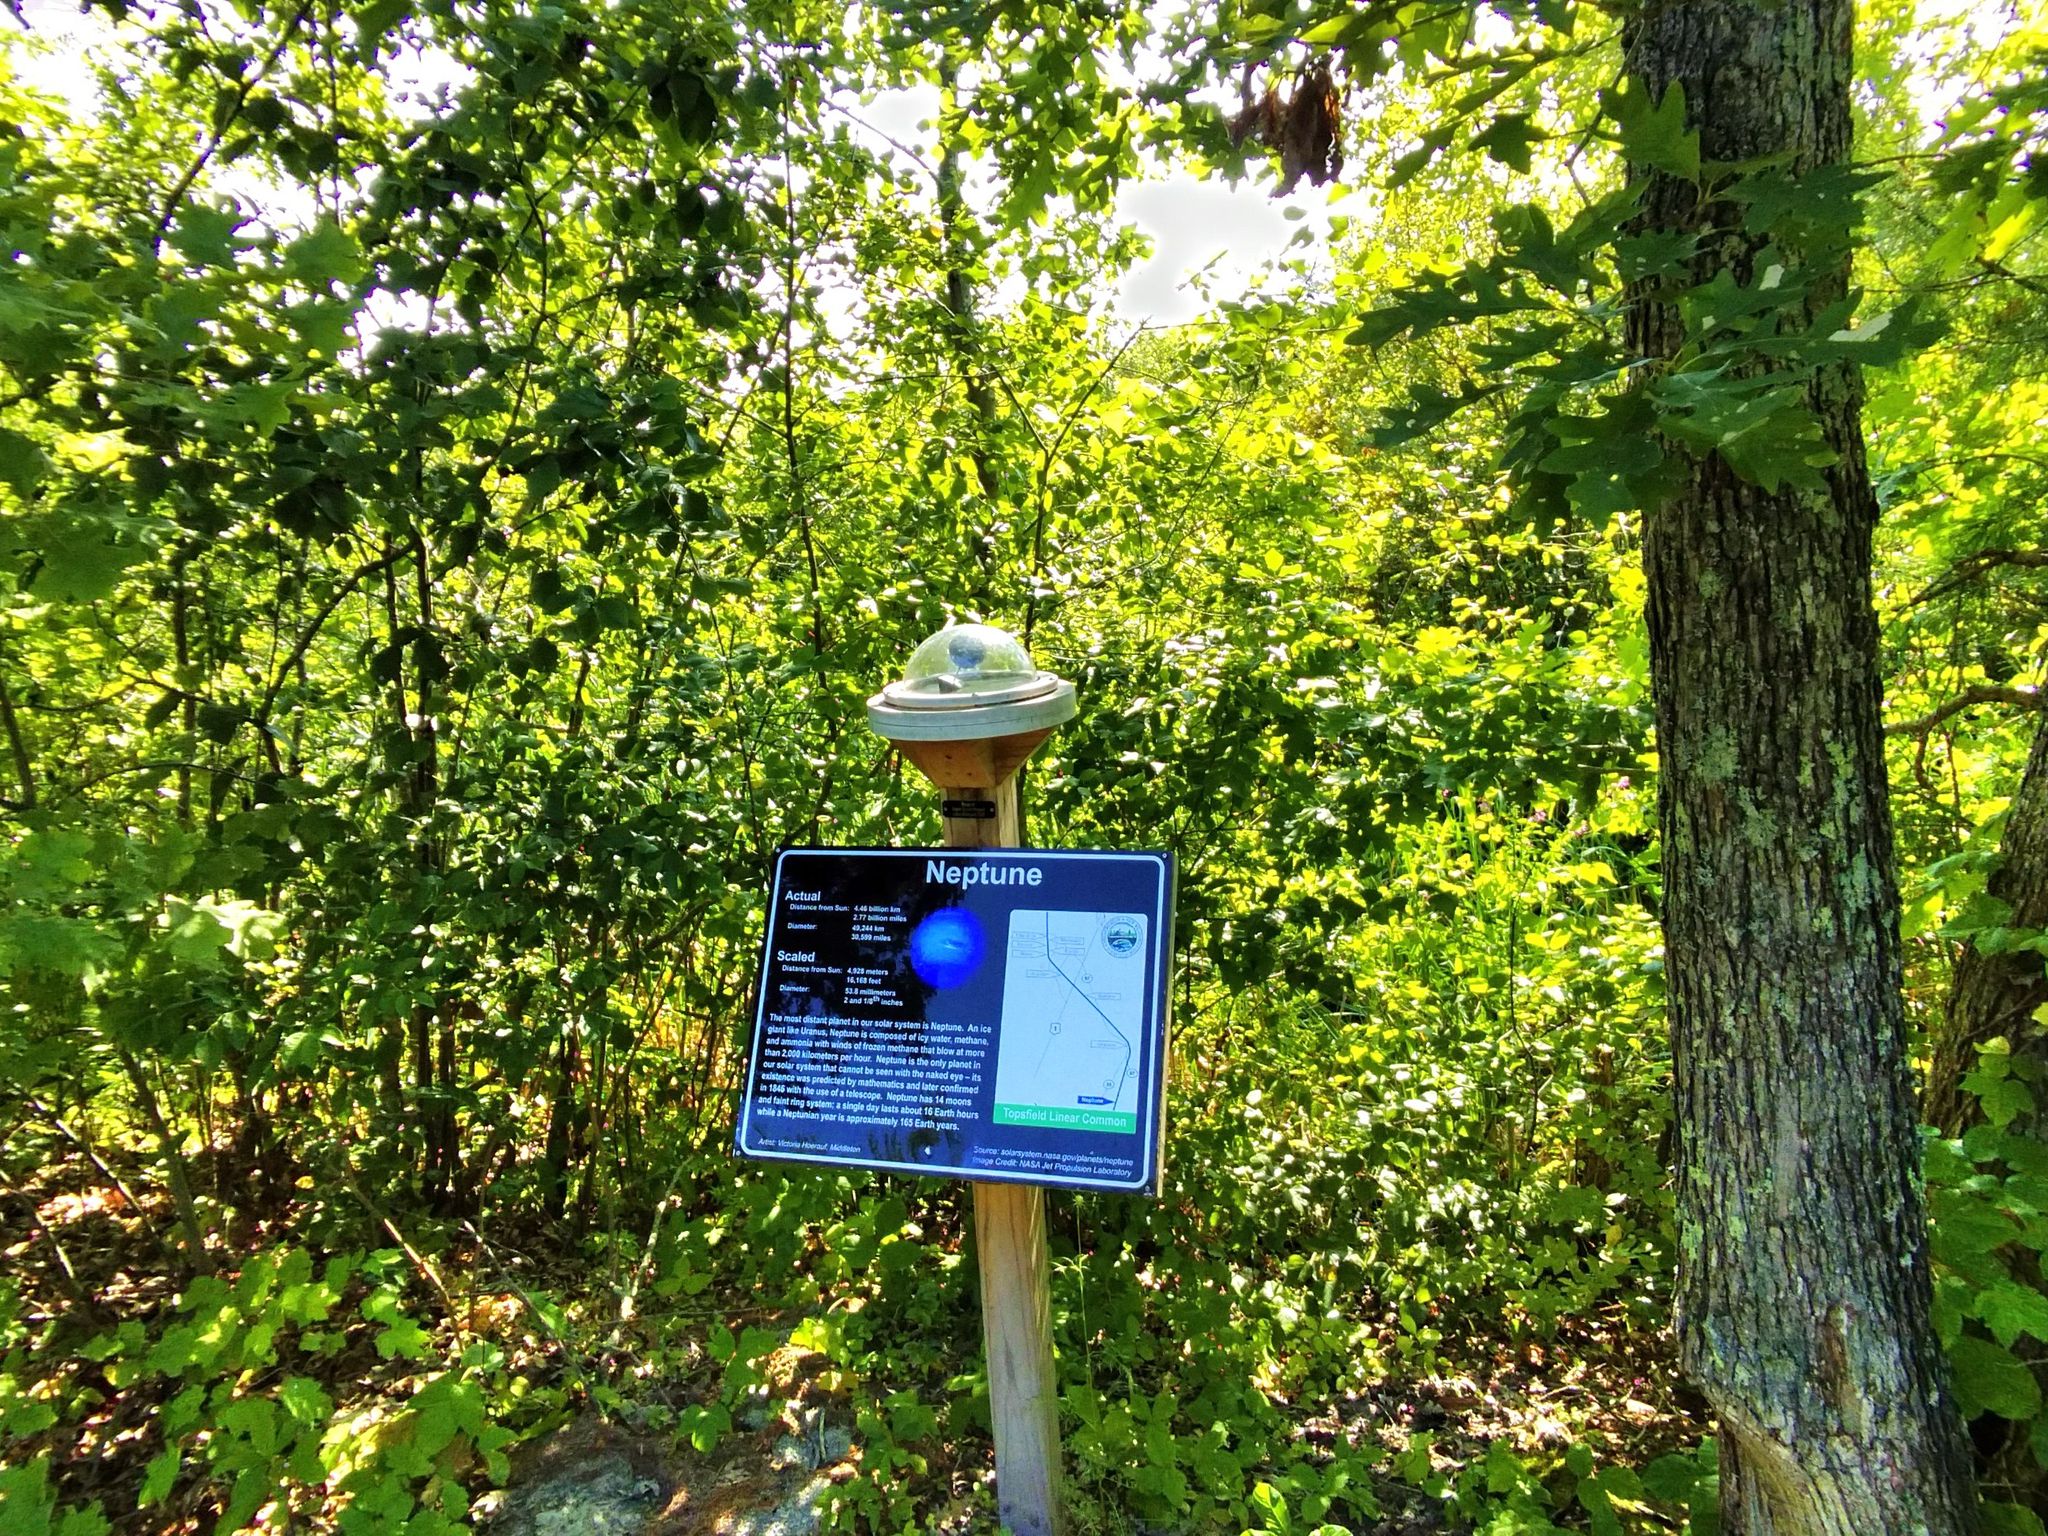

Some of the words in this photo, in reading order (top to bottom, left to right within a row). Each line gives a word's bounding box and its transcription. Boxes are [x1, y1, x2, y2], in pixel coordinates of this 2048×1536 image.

[926, 860, 1042, 890] Neptune
[785, 890, 821, 901] Actual
[777, 950, 816, 962] Scaled
[828, 1017, 850, 1025] planet
[895, 1020, 920, 1030] system
[931, 1022, 964, 1032] Neptune.
[981, 1024, 991, 1032] ice
[768, 1026, 785, 1034] giant
[801, 1027, 827, 1036] Uranus,
[830, 1029, 859, 1038] Neptune
[869, 1032, 907, 1040] composed
[918, 1034, 929, 1043] icy
[931, 1035, 952, 1043] water,
[954, 1036, 989, 1046] methane,
[831, 1040, 852, 1049] winds
[863, 1042, 885, 1051] frozen
[887, 1044, 918, 1053] methane
[921, 1046, 935, 1054] that
[936, 1047, 954, 1055] blow
[966, 1049, 985, 1057] more
[782, 1050, 800, 1058] 2,000
[802, 1051, 838, 1060] kilometers
[840, 1054, 852, 1062] per
[854, 1054, 872, 1062] hour.
[876, 1055, 906, 1064] Neptune
[917, 1058, 928, 1066] the
[930, 1059, 946, 1069] only
[948, 1060, 972, 1069] planet
[777, 1061, 795, 1069] solar
[796, 1063, 822, 1072] system
[823, 1064, 837, 1072] that
[838, 1065, 863, 1074] cannot
[865, 1066, 874, 1075] be
[895, 1068, 911, 1077] with
[912, 1069, 924, 1077] the
[926, 1070, 948, 1079] naked
[950, 1073, 963, 1082] eye
[972, 1073, 981, 1081] its
[762, 1072, 795, 1081] existence
[812, 1075, 846, 1085] predicted
[847, 1078, 857, 1087] by
[858, 1078, 904, 1089] mathematics
[906, 1081, 920, 1090] and
[922, 1082, 938, 1091] later
[940, 1082, 979, 1094] confirmed
[769, 1084, 785, 1092] 1846
[787, 1085, 801, 1094] with
[803, 1086, 814, 1095] the
[816, 1088, 829, 1096] use
[831, 1088, 839, 1096] of
[846, 1089, 882, 1100] telescope.
[887, 1092, 917, 1102] Neptune
[920, 1094, 933, 1103] has
[946, 1096, 972, 1106] moons
[773, 1096, 789, 1105] faint
[790, 1097, 804, 1108] ring
[843, 1101, 864, 1111] single
[866, 1102, 879, 1113] day
[881, 1104, 899, 1113] lasts
[901, 1105, 922, 1114] about
[924, 1107, 932, 1116] 16
[934, 1108, 954, 1117] Earth
[956, 1109, 979, 1119] hours
[1003, 1107, 1046, 1121] Topsfield
[1050, 1110, 1080, 1122] Linear
[1082, 1112, 1126, 1127] Common
[757, 1108, 776, 1116] while
[783, 1109, 819, 1119] Neptunian
[821, 1112, 836, 1122] year
[838, 1113, 844, 1121] is
[846, 1114, 898, 1127] approximately
[900, 1118, 913, 1127] 165
[915, 1119, 934, 1128] Earth
[936, 1121, 959, 1131] years.
[778, 1140, 800, 1148] Victoria
[974, 1146, 999, 1154] Source:
[973, 1157, 993, 1165] Image
[995, 1158, 1018, 1166] Credit:
[1019, 1160, 1040, 1168] NASA
[1054, 1163, 1091, 1172] Propulsion
[1093, 1166, 1132, 1178] Laboratory
